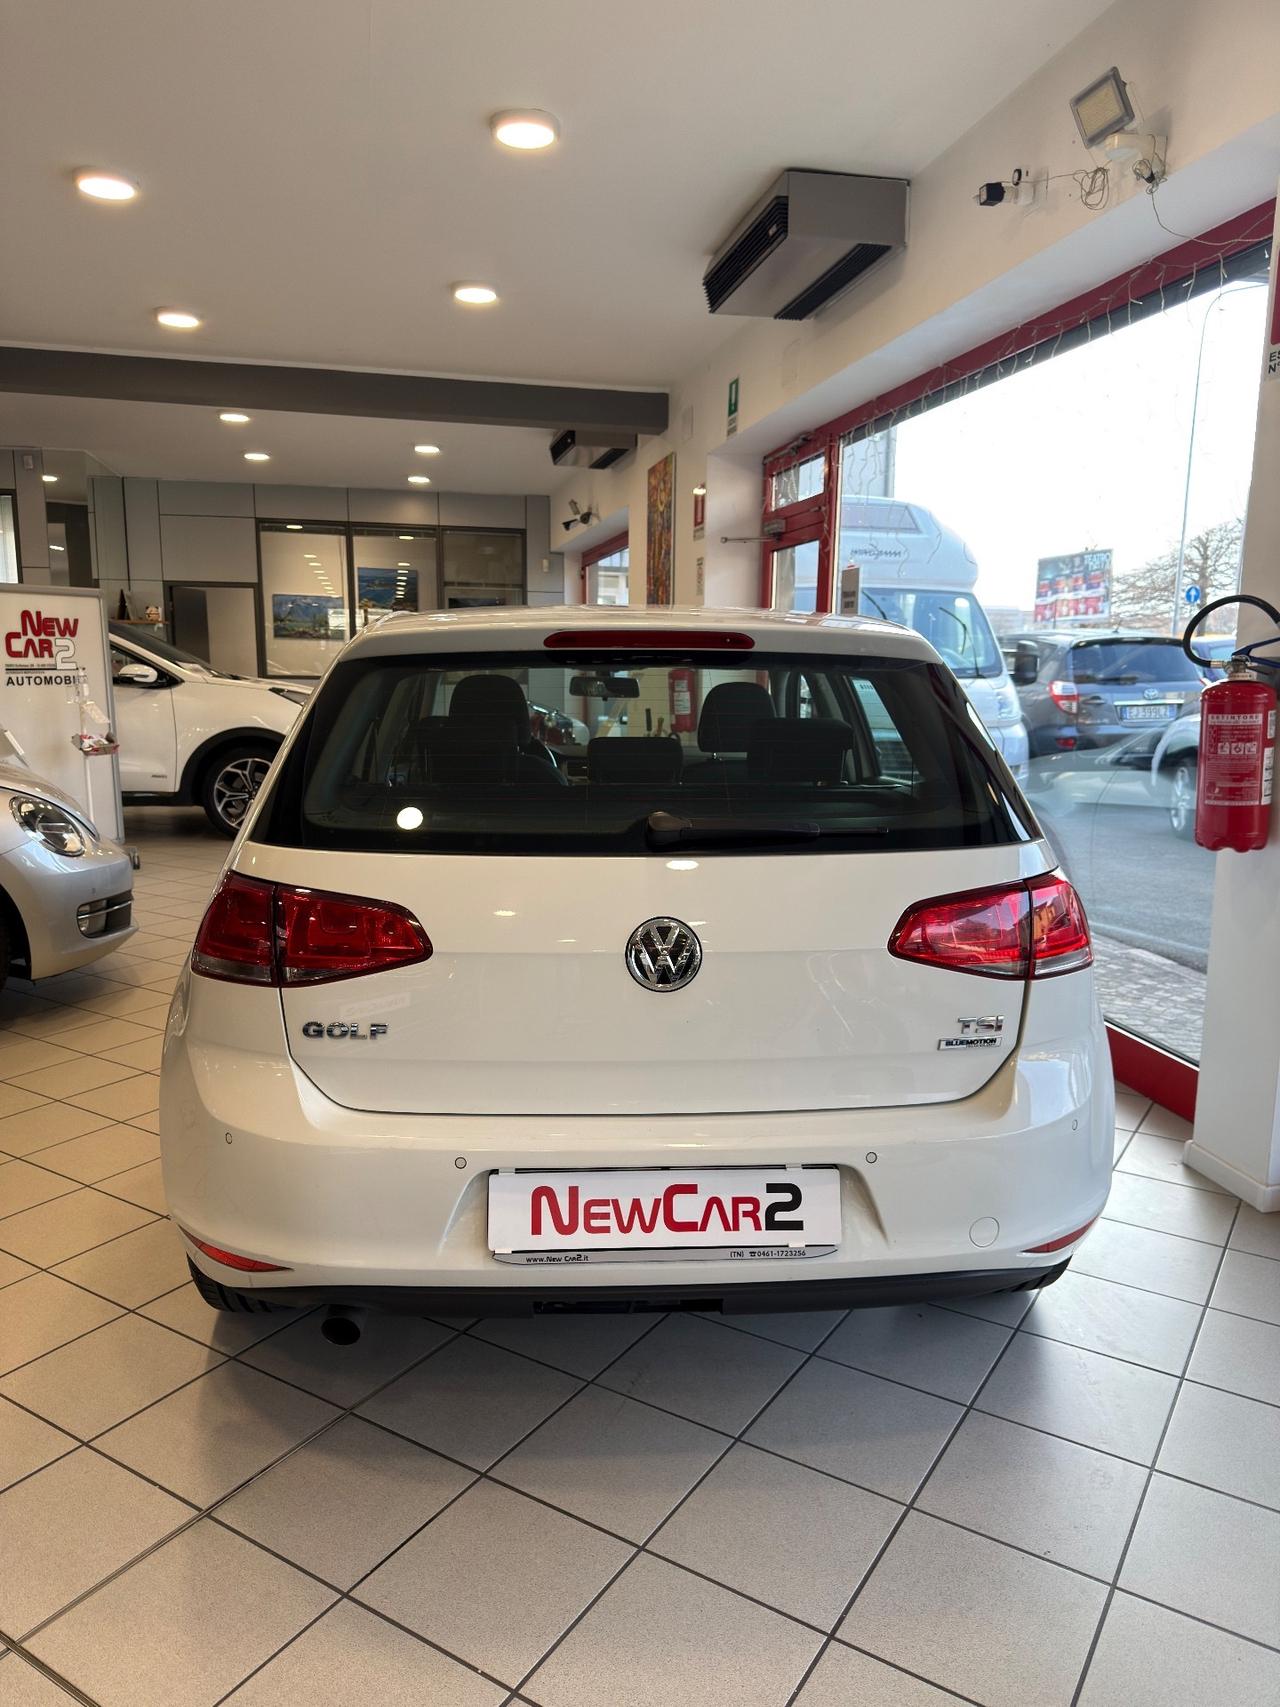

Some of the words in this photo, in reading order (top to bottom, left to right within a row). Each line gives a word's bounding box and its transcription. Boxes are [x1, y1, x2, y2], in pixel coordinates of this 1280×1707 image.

[302, 1021, 389, 1040] GOLF
[957, 1015, 1004, 1034] TSI
[945, 1038, 997, 1047] BLUEMOTION
[729, 1251, 745, 1259] (TN)
